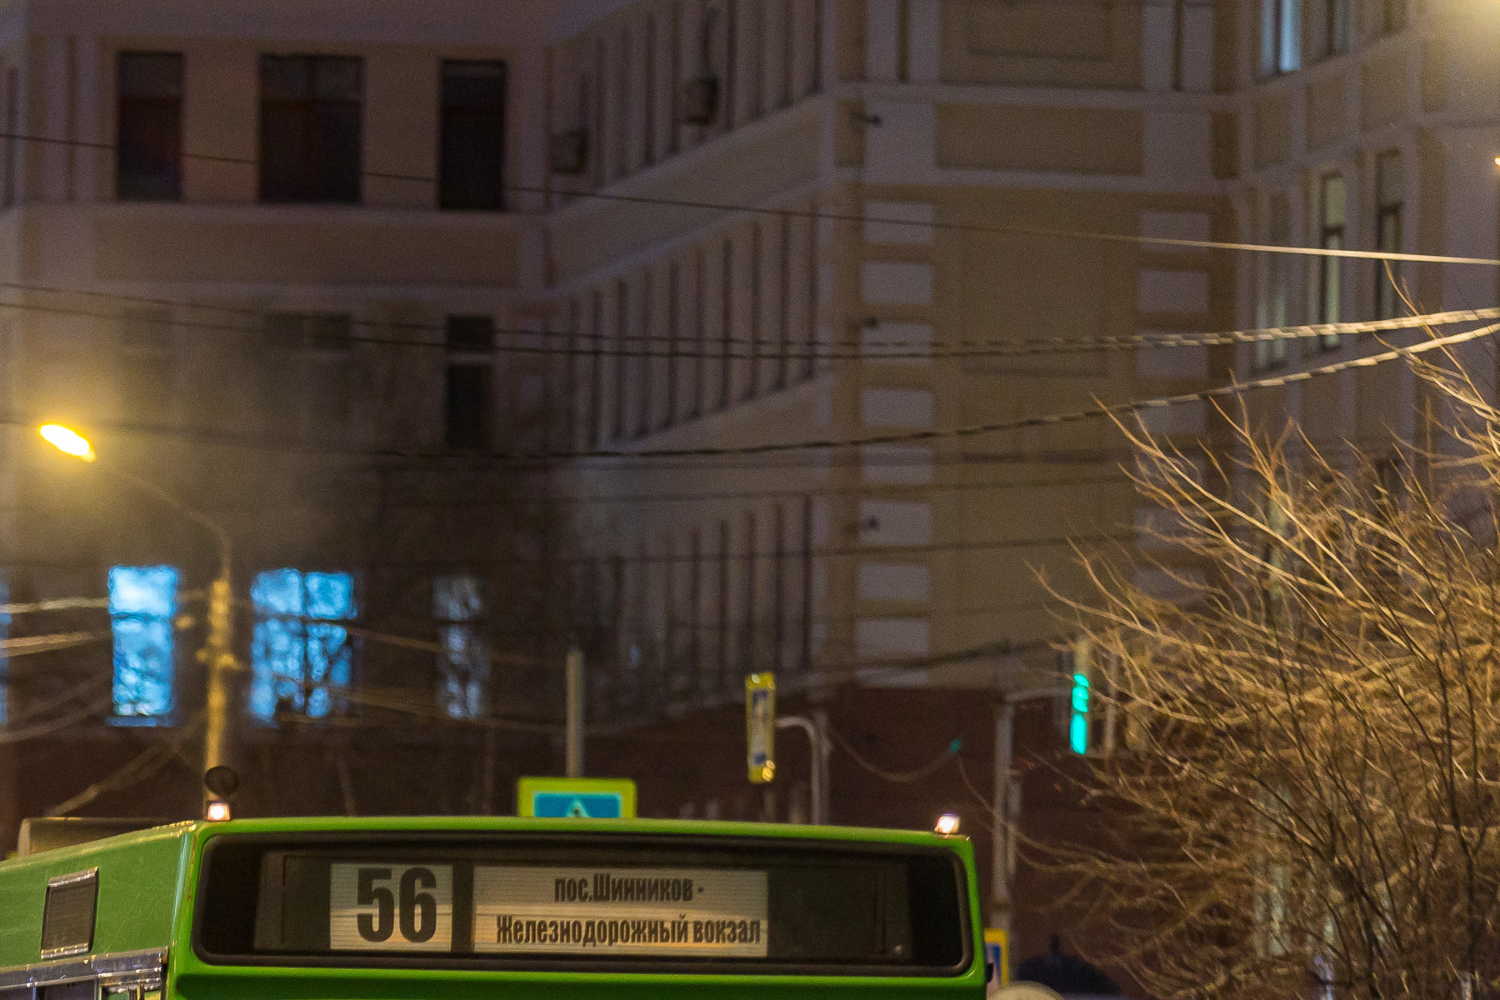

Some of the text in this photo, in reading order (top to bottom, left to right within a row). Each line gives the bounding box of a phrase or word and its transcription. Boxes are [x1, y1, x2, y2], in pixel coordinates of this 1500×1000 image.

[554, 873, 693, 902] пос.Шинников
[356, 867, 437, 943] 56
[497, 914, 760, 947] Железнодорожный вокзал
